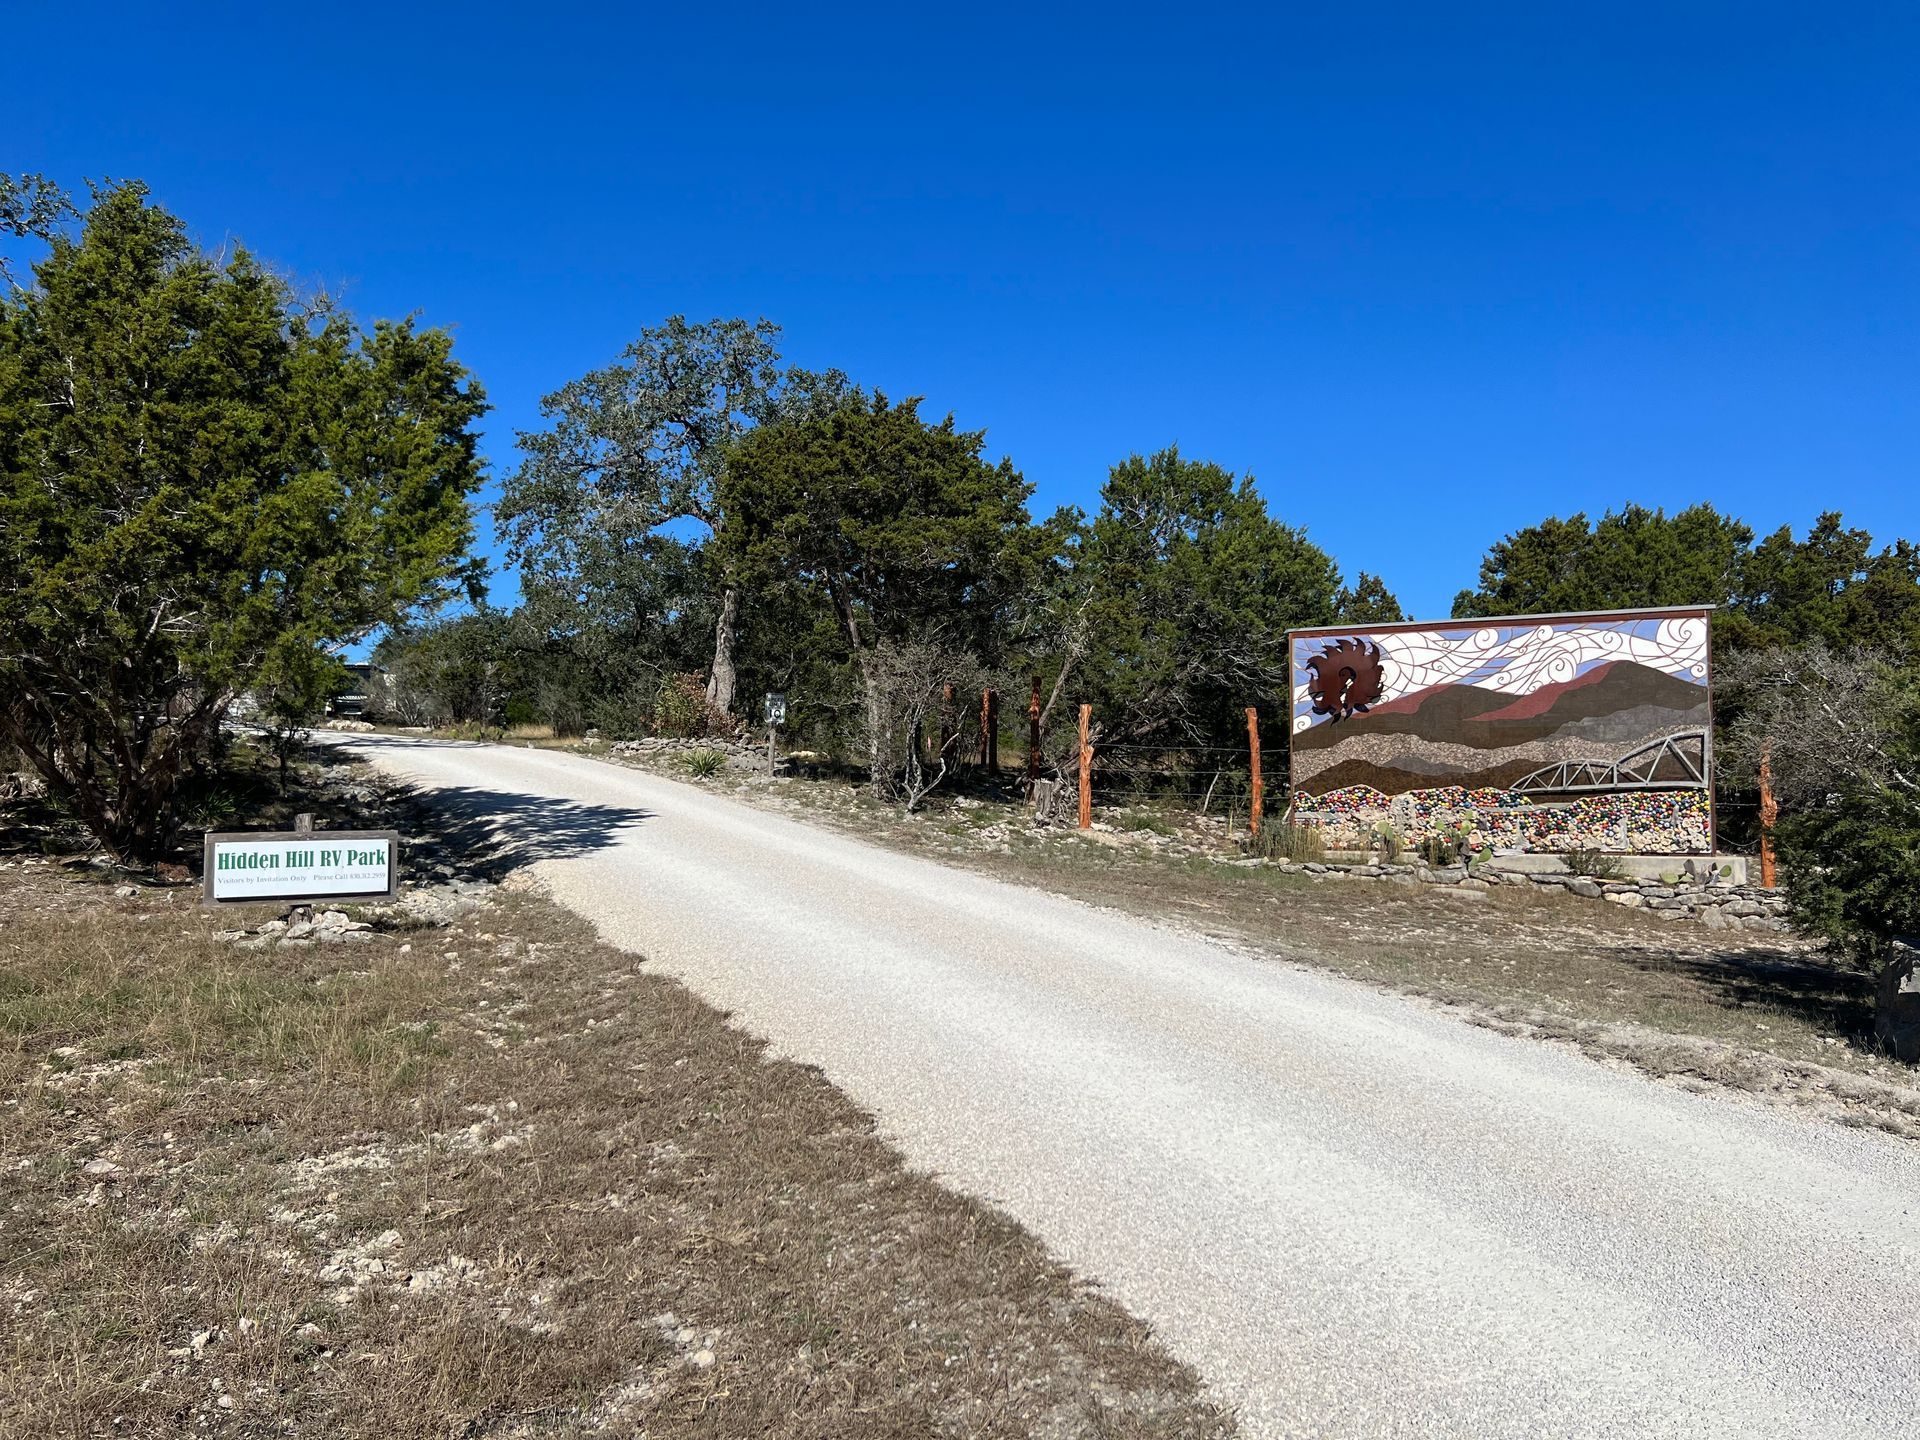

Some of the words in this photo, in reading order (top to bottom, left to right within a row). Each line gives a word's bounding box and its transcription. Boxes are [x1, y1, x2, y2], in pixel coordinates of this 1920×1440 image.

[769, 709, 781, 718] 10
[217, 852, 279, 870] Hidden
[285, 850, 314, 868] Hill
[320, 850, 342, 867] RV
[347, 849, 386, 866] Park
[246, 877, 254, 885] by
[290, 875, 307, 883] Only
